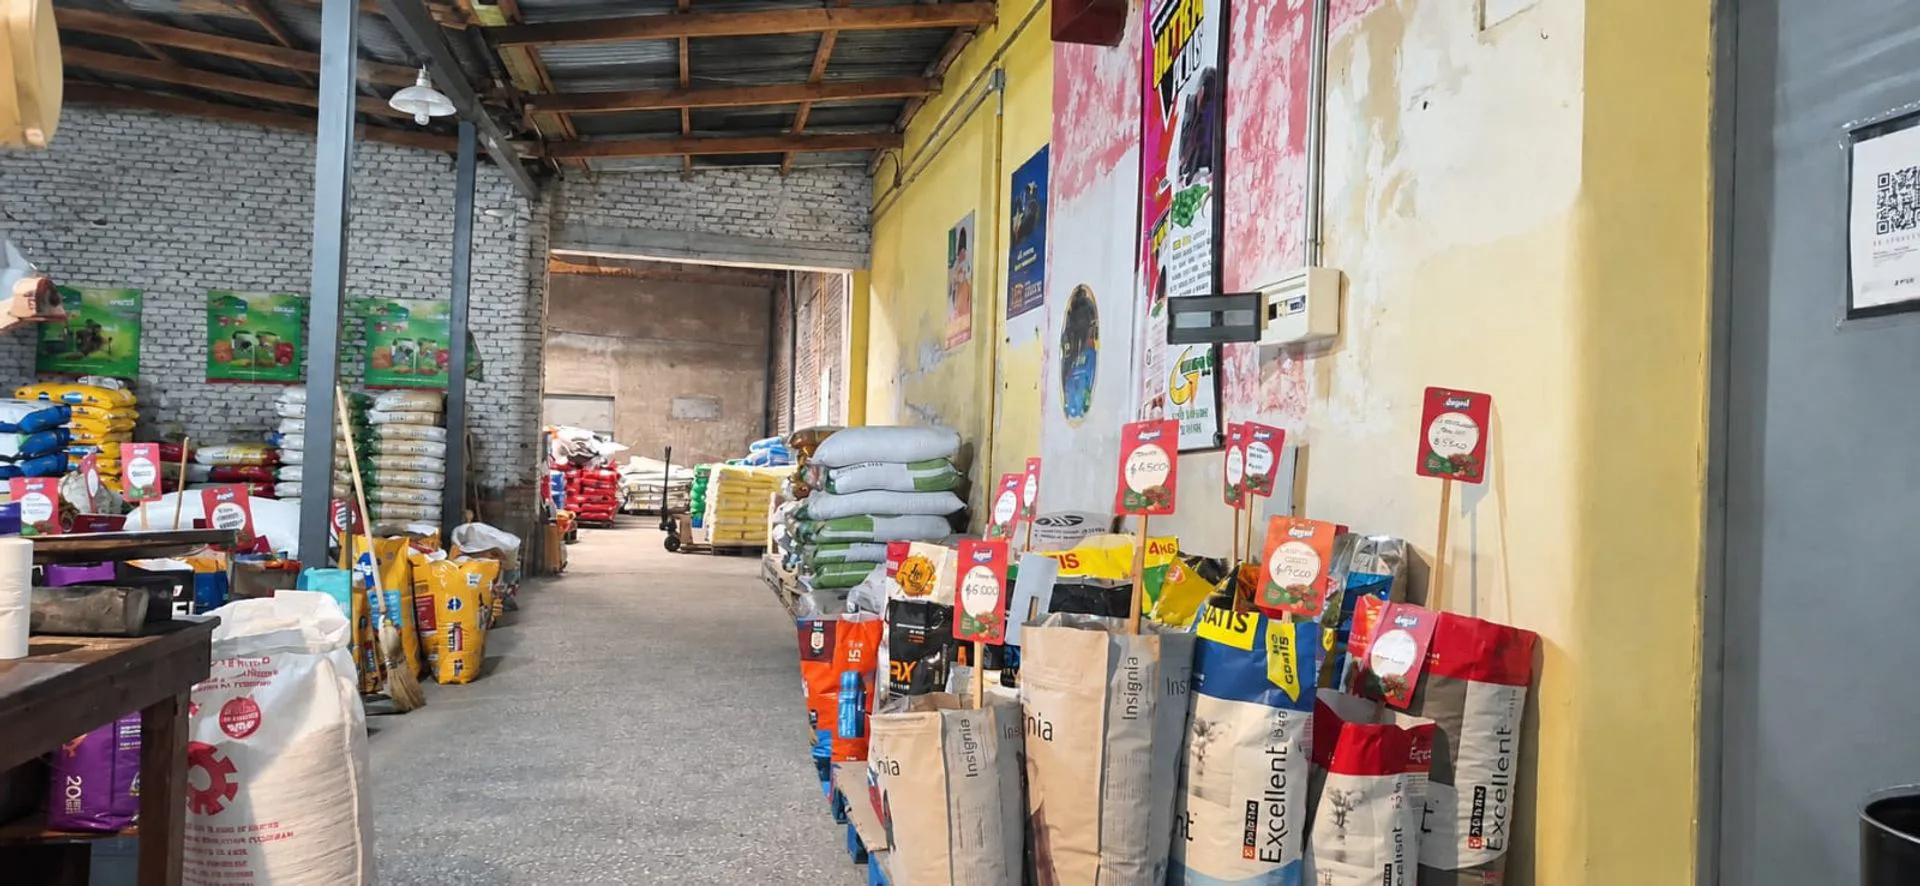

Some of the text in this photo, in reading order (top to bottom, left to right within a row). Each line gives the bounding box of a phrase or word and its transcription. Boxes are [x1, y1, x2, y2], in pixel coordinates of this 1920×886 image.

[1122, 656, 1142, 720] Insignia
[1259, 746, 1289, 863] Excellent
[1486, 726, 1512, 850] Excellent
